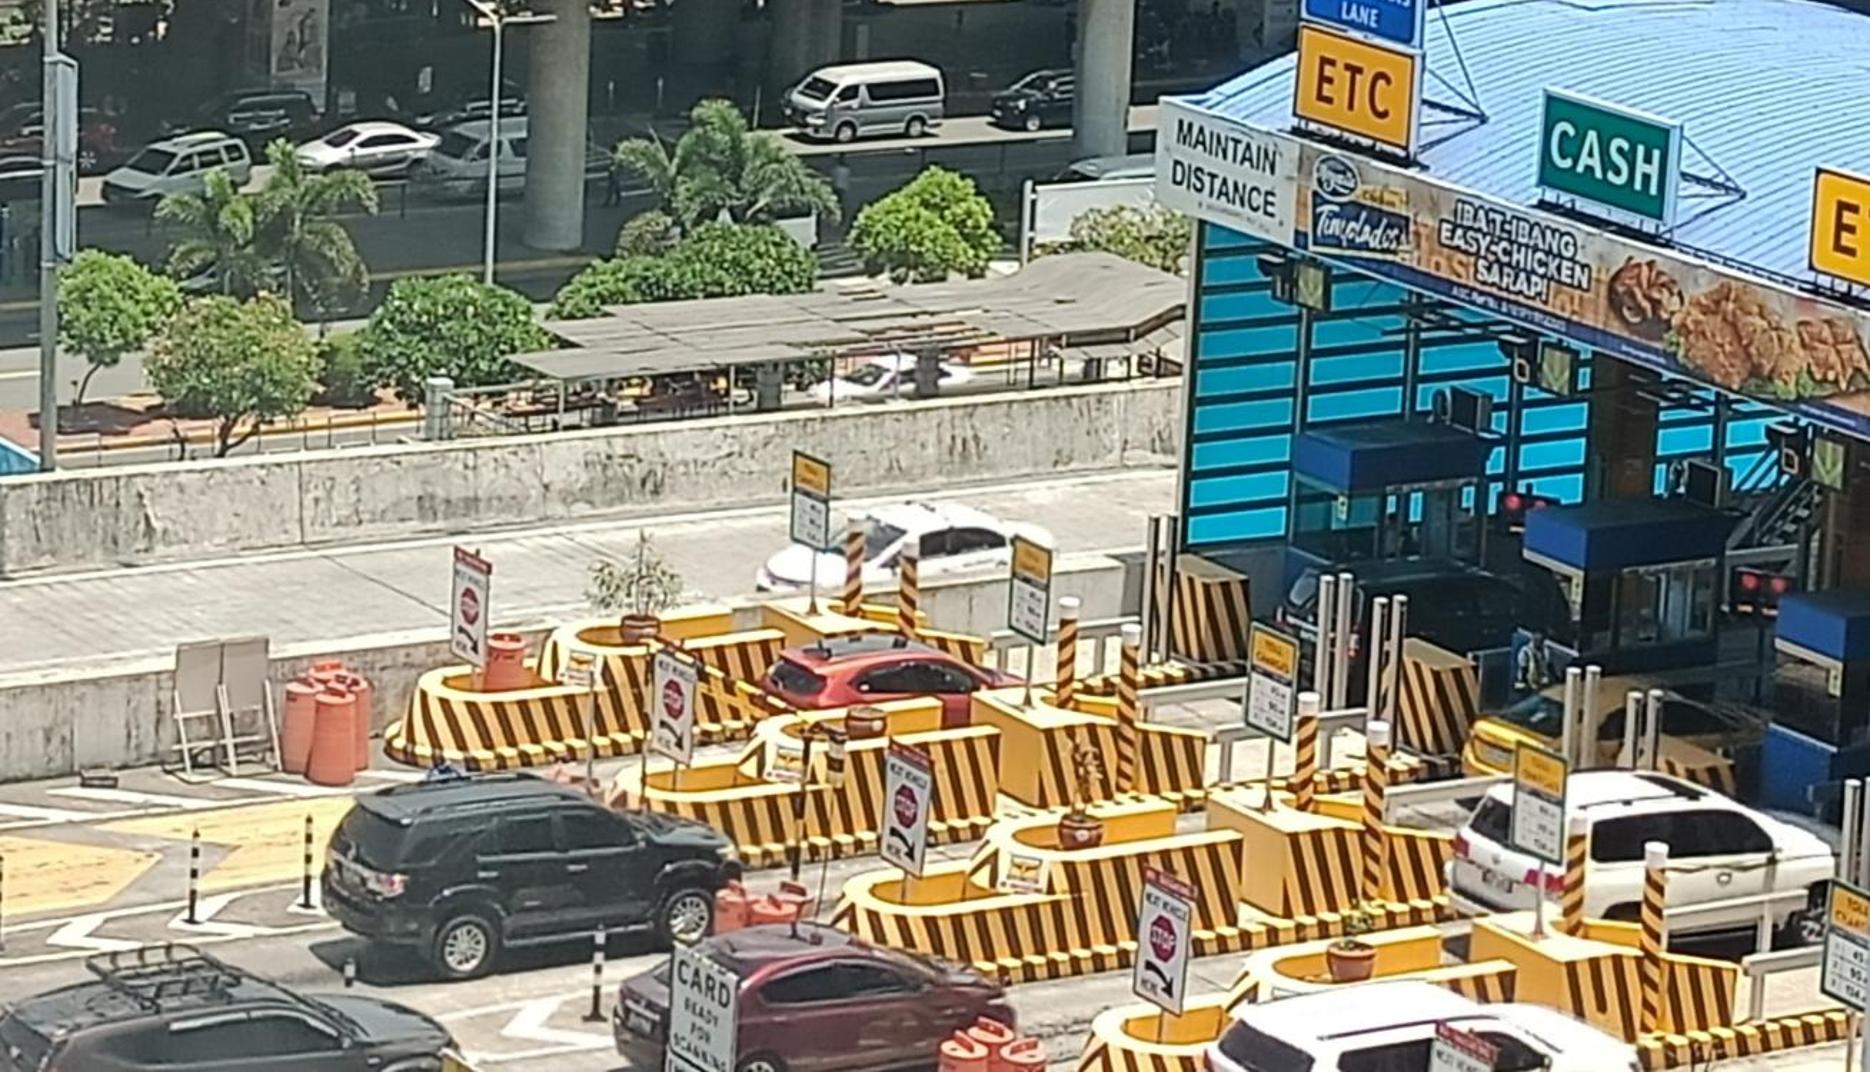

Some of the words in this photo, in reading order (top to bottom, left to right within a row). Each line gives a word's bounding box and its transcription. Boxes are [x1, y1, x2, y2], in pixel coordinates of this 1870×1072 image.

[1341, 1, 1379, 28] LANE
[1316, 55, 1392, 119] ETC
[1176, 118, 1277, 176] MAINTAIN
[1551, 121, 1660, 196] CASH
[1172, 159, 1277, 218] DISTANCE
[1440, 220, 1590, 290] EASY-CHICKEN
[1456, 200, 1576, 258] IBAT-IBANG
[1151, 926, 1177, 951] STOP
[678, 959, 731, 1008] CARD
